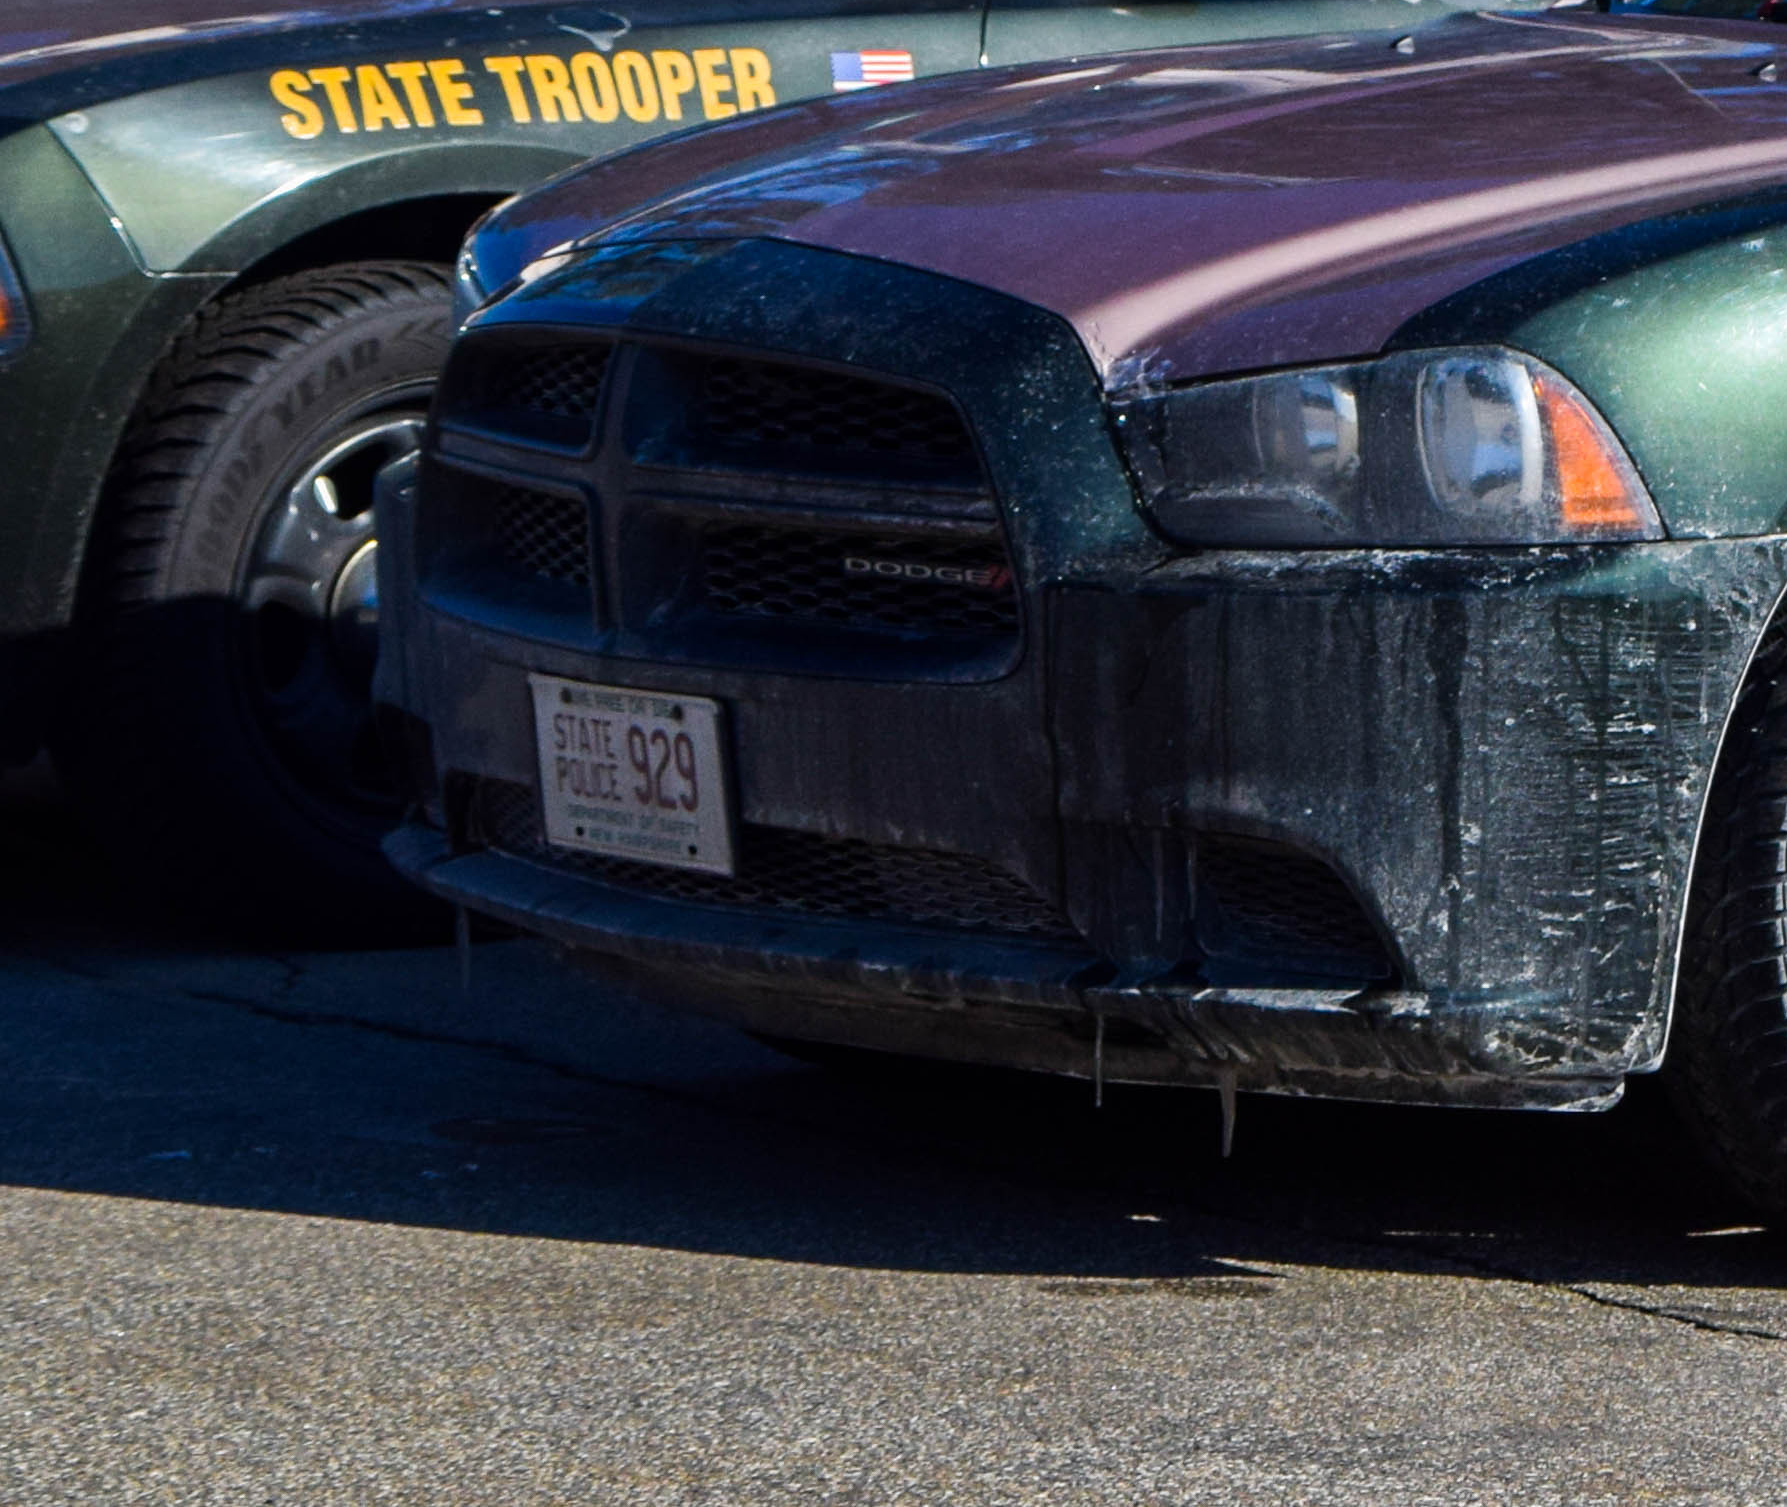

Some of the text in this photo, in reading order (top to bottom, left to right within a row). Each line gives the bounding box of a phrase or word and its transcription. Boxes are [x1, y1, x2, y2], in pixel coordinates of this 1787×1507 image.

[268, 48, 777, 140] STATE TROOPER
[844, 556, 991, 586] DODGE
[554, 713, 616, 759] STATE
[555, 755, 623, 802] POLICE
[628, 723, 699, 813] 929
